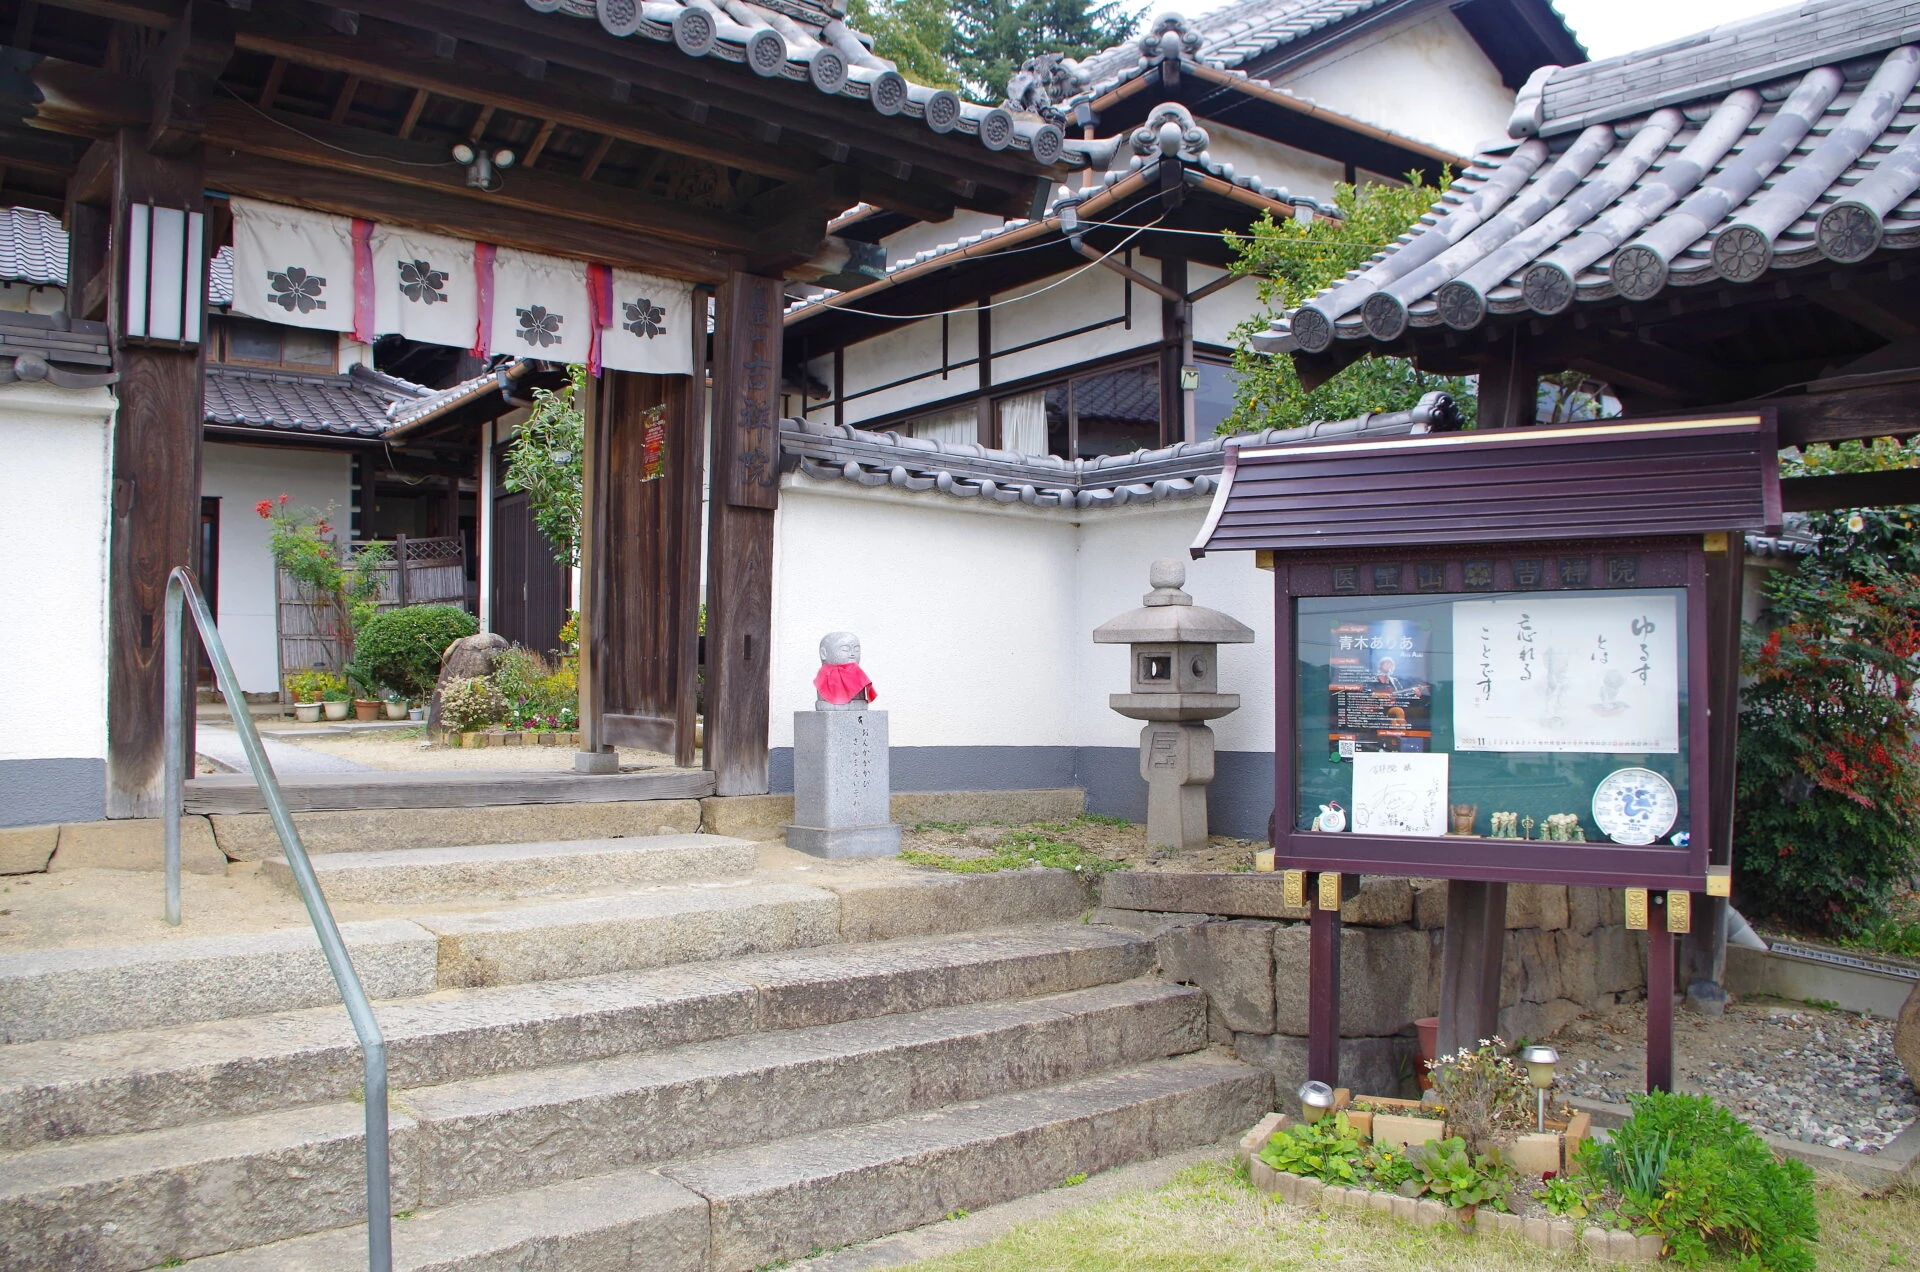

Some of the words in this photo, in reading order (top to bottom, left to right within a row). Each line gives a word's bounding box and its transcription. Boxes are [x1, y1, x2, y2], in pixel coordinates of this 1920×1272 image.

[1334, 566, 1443, 590] 医王山
[1517, 559, 1636, 585] 吉祥院
[1339, 635, 1414, 650] 青木ありあ
[1517, 613, 1537, 681] 忘れる
[1591, 634, 1609, 664] とは
[1631, 615, 1656, 686] ゆるす
[1477, 627, 1495, 701] ことです
[1477, 737, 1486, 746] 11
